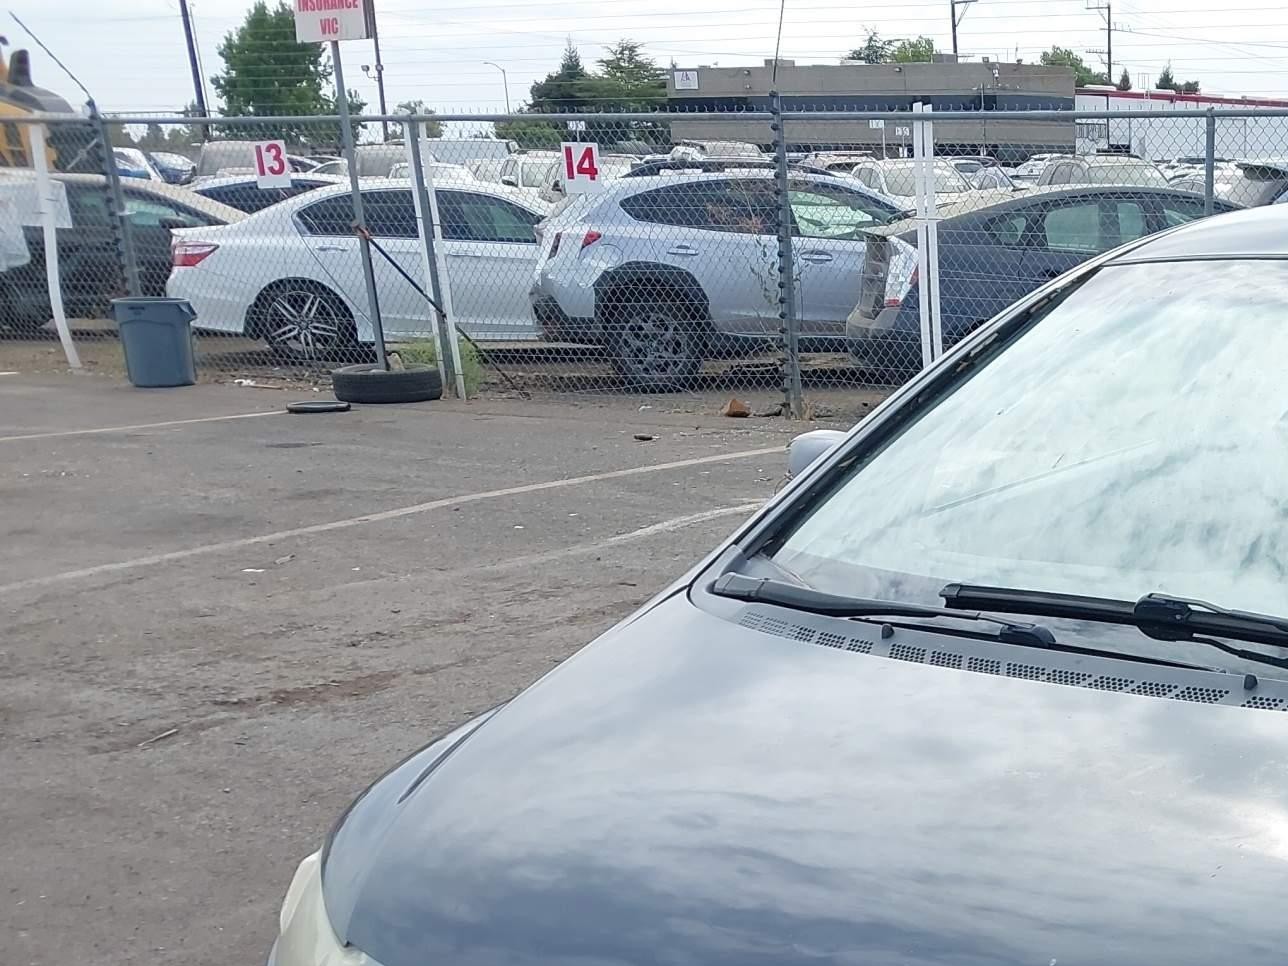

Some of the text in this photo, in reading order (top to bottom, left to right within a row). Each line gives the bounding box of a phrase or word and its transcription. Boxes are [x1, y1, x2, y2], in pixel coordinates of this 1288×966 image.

[320, 18, 339, 35] VIC
[255, 143, 285, 176] 13
[564, 145, 598, 181] 14
